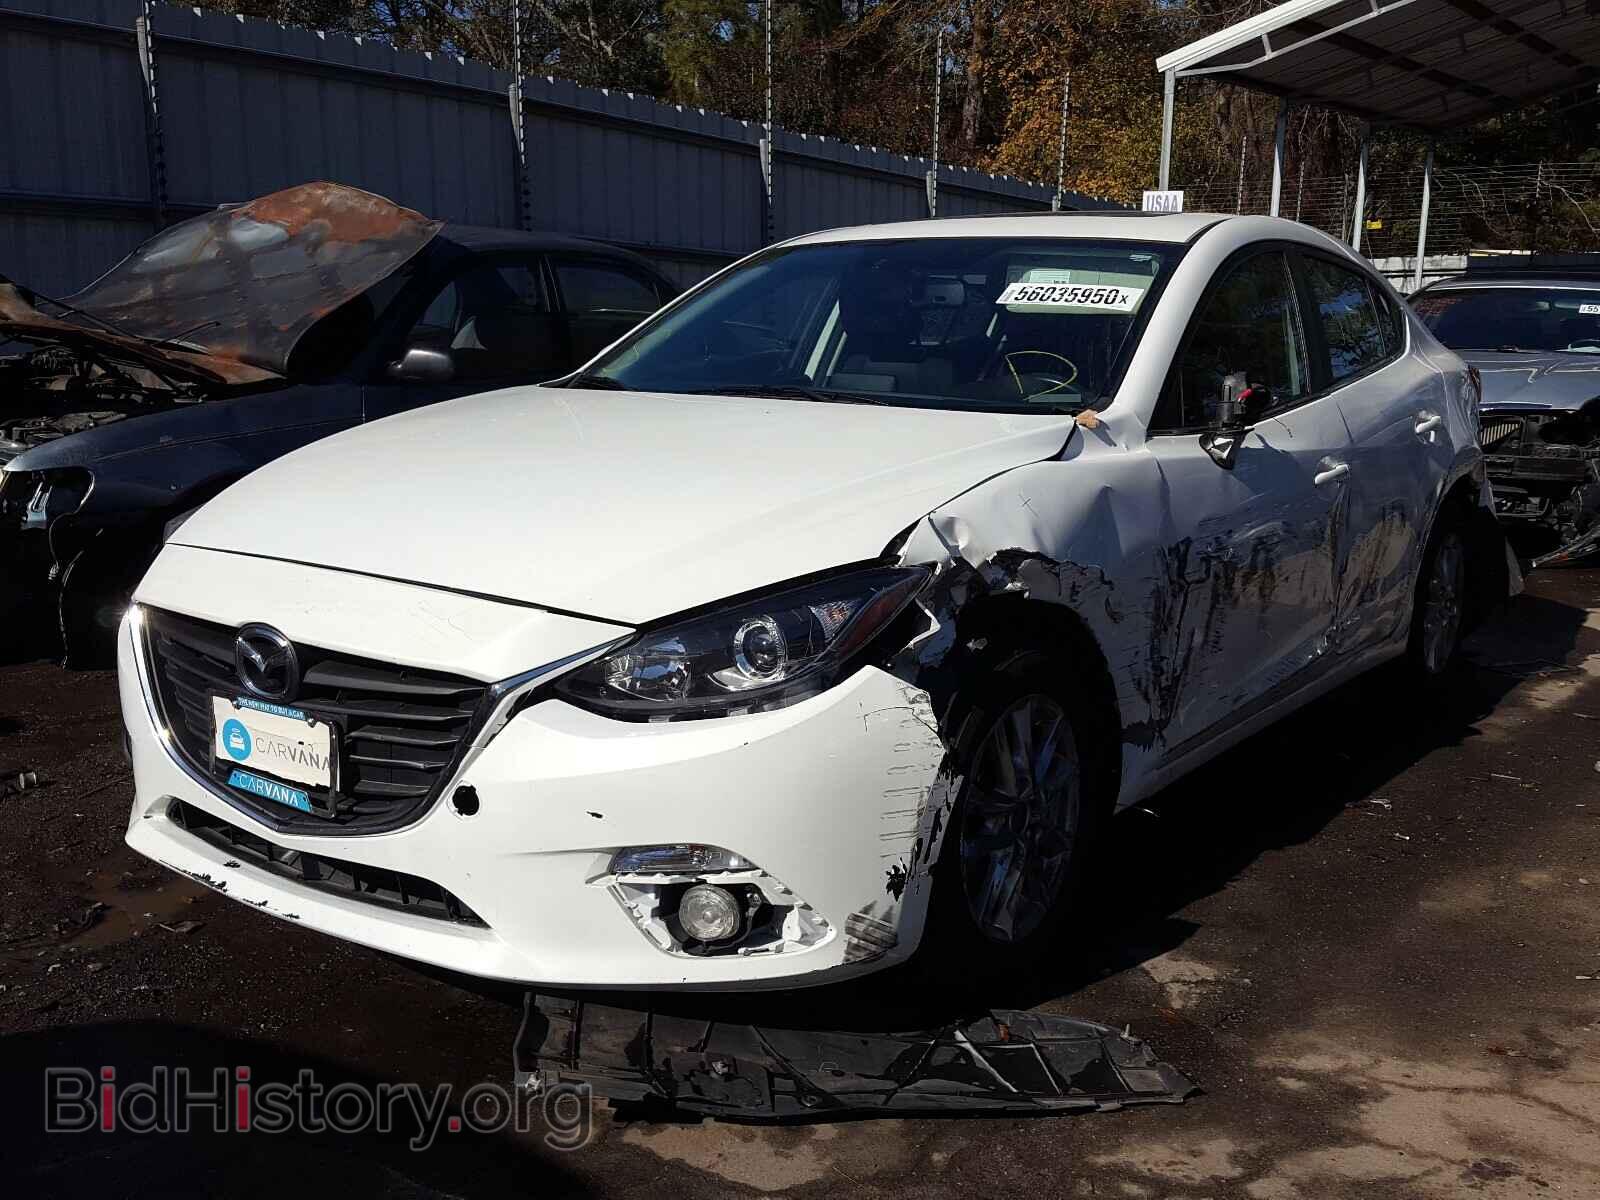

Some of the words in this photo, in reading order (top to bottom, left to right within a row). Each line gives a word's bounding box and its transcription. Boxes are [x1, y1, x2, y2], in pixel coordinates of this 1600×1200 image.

[1146, 194, 1178, 212] USAA
[255, 736, 330, 771] CARVANA
[239, 774, 299, 807] CARVANA
